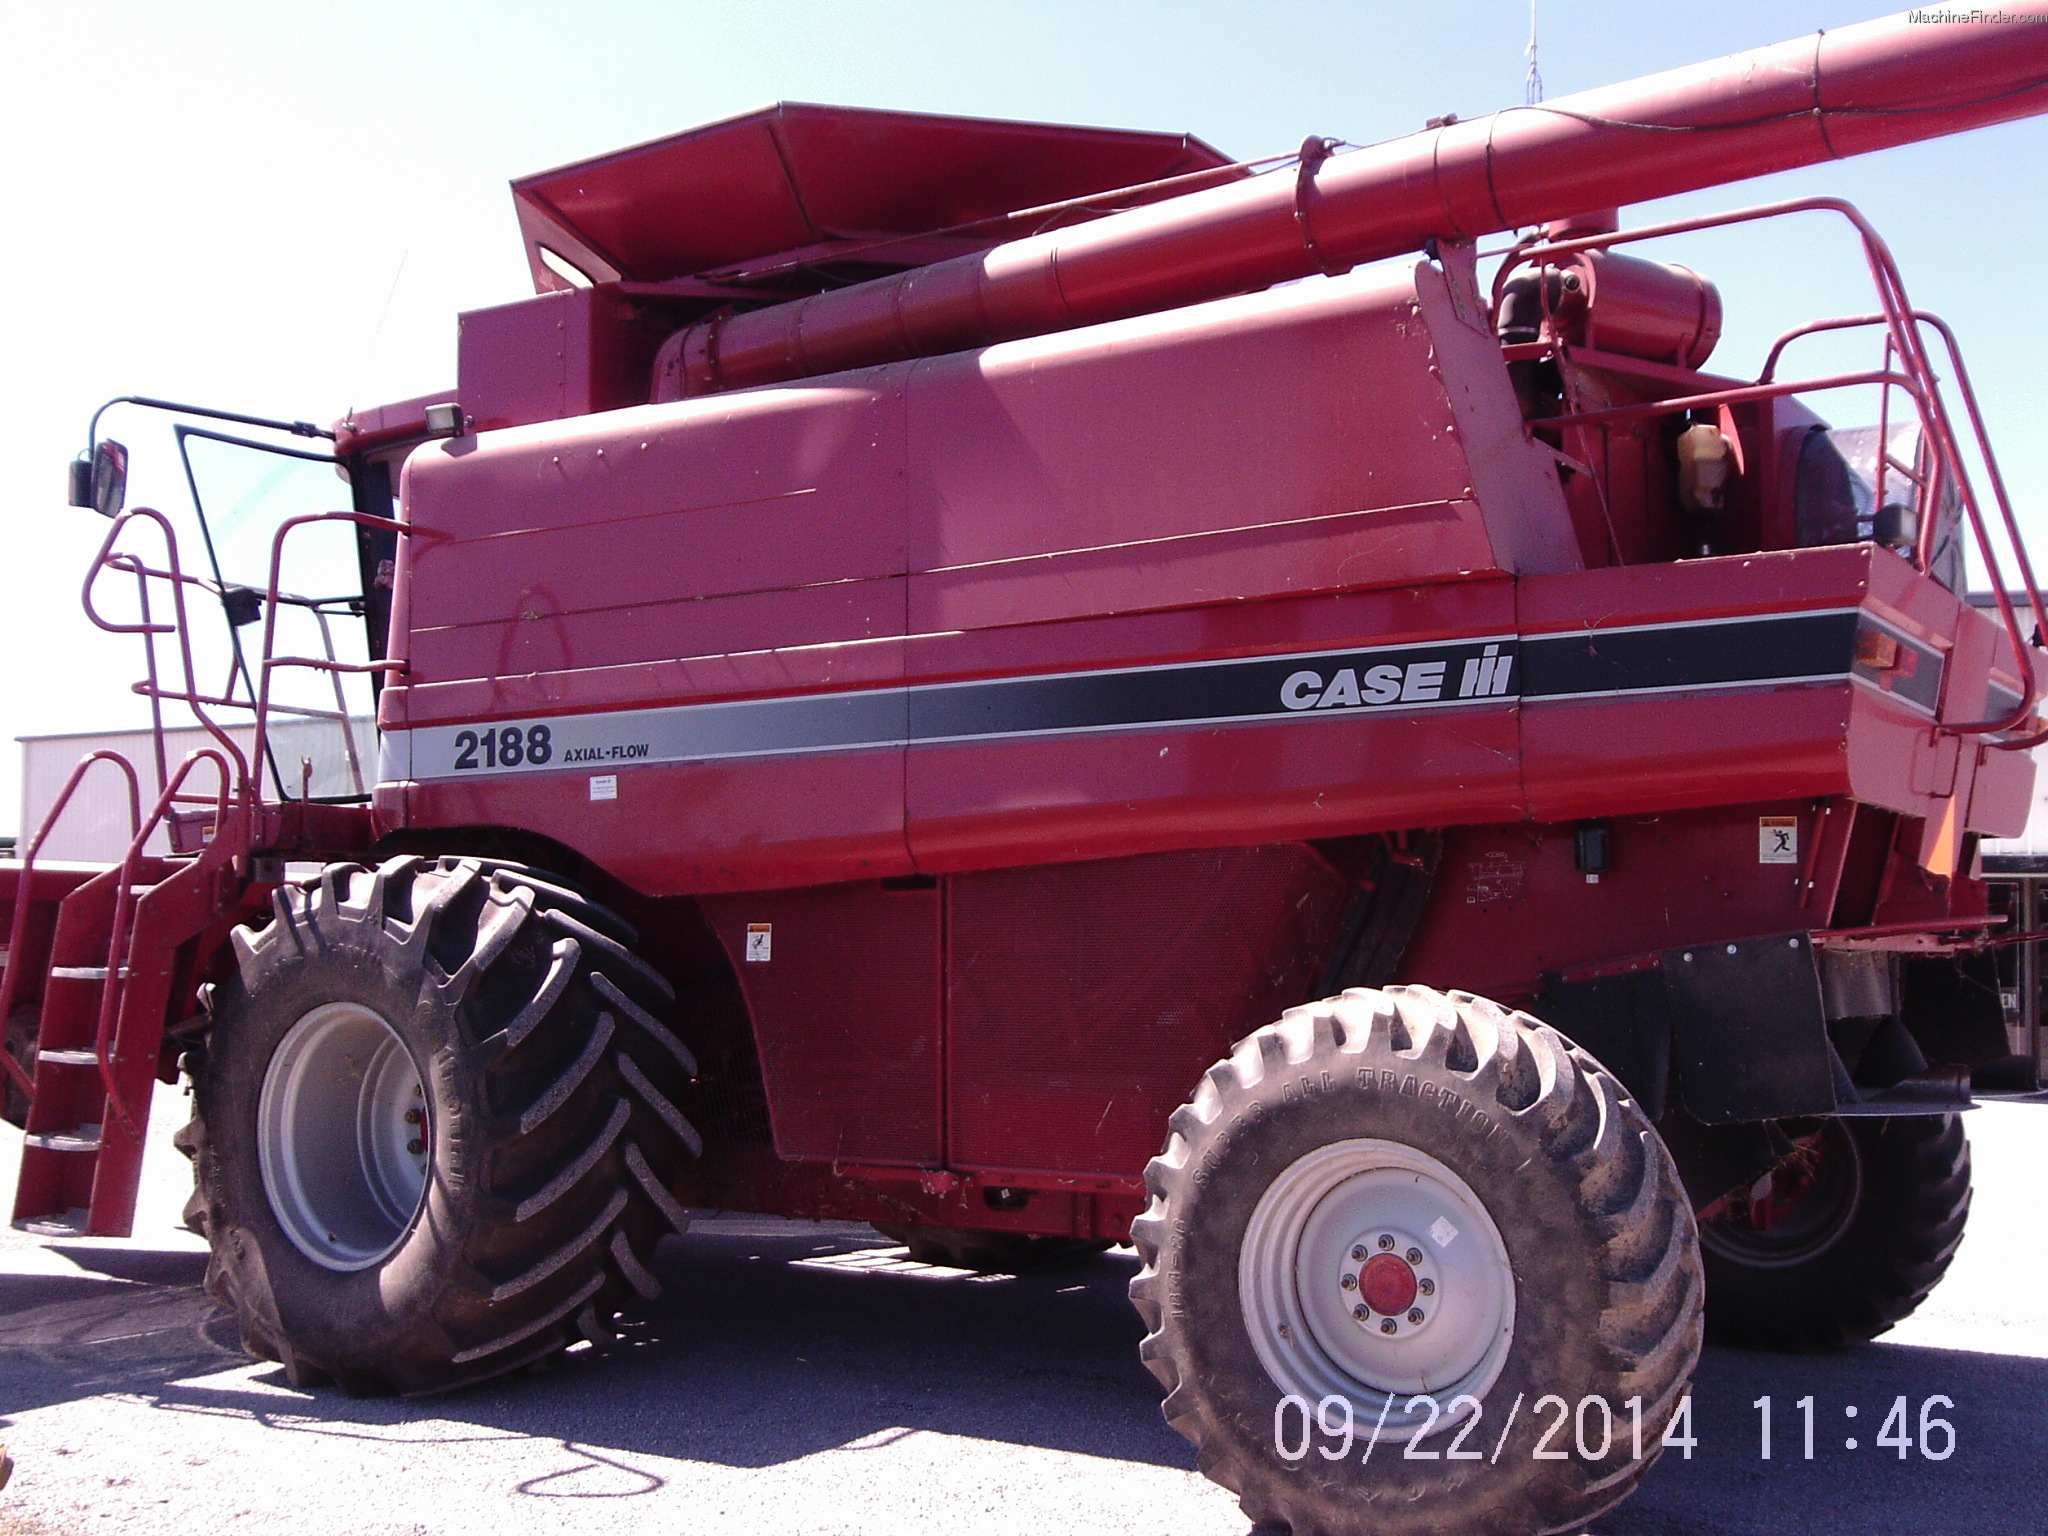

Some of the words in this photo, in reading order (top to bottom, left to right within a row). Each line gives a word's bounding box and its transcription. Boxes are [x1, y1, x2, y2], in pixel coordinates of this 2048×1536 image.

[1280, 661, 1447, 710] CASE
[454, 724, 552, 770] 2188
[564, 744, 649, 762] AXIAL-FLOW
[1282, 1070, 1336, 1101] ALL
